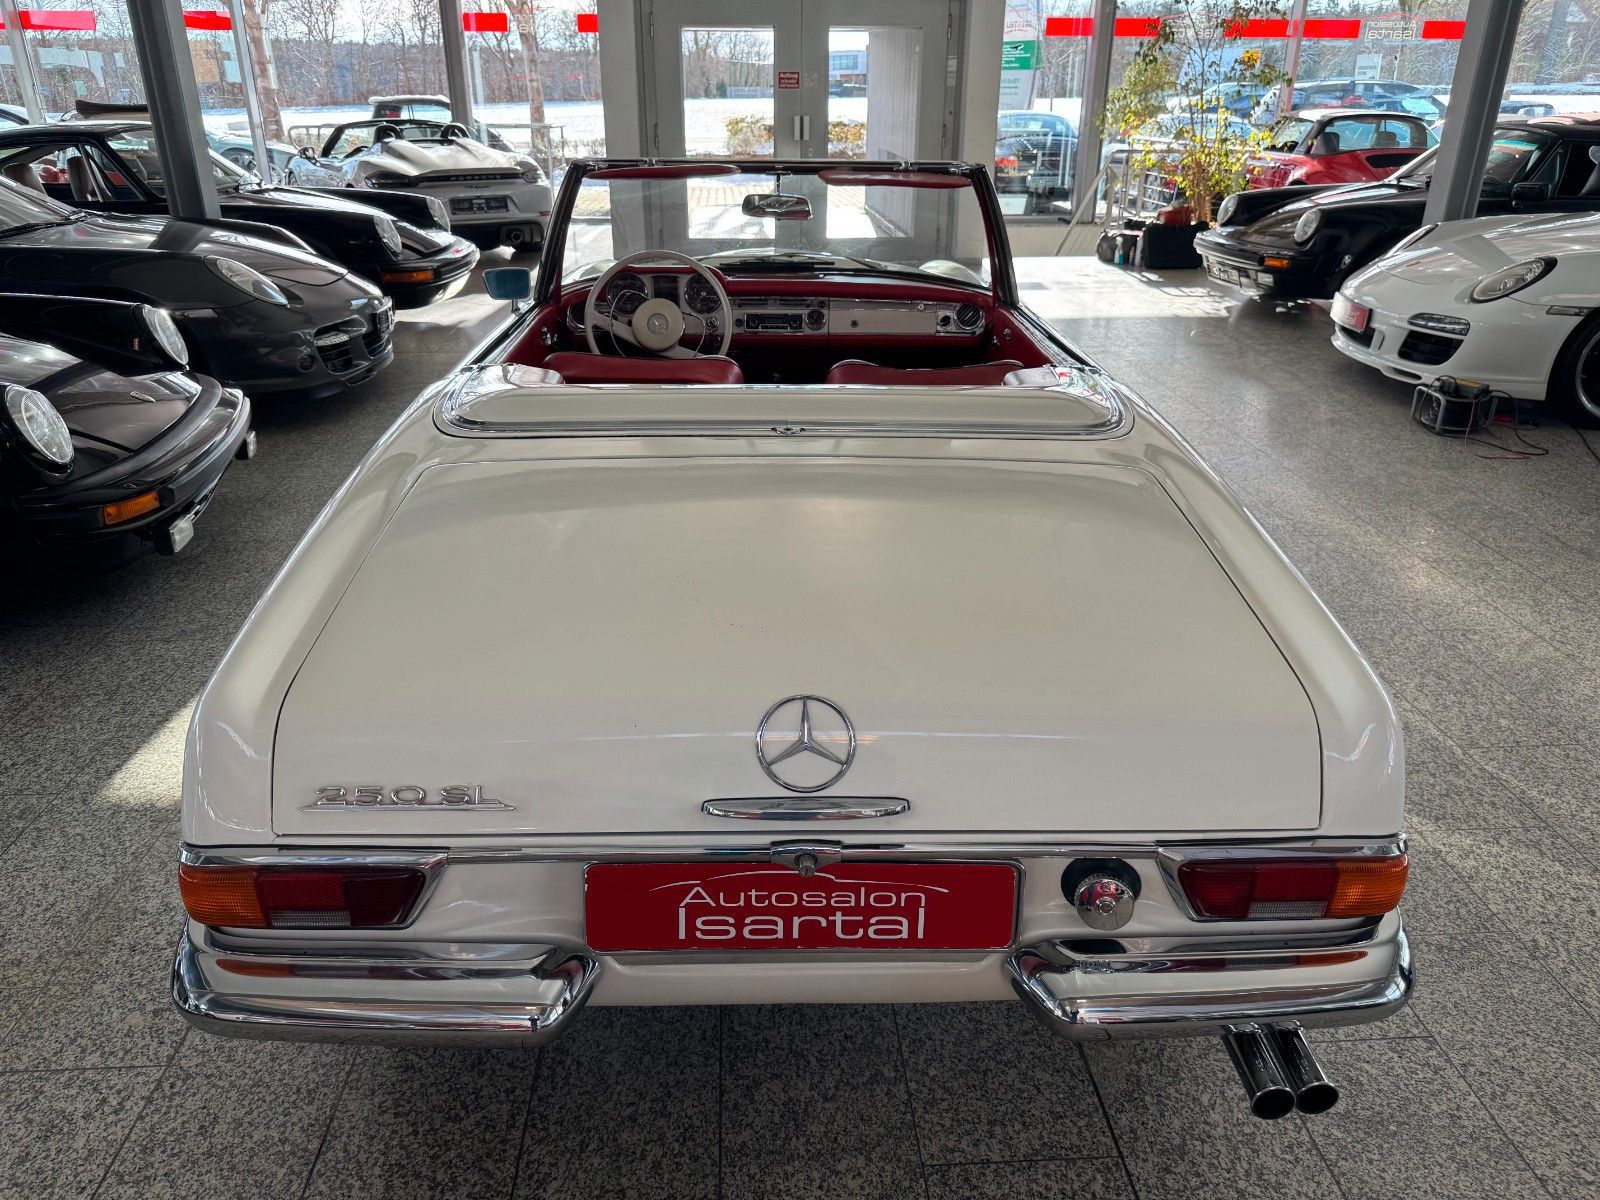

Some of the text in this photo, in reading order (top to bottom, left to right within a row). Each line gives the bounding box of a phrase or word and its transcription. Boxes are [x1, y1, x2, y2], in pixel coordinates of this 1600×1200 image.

[316, 785, 504, 806] 250 SL
[679, 886, 926, 907] Autosalon
[678, 907, 925, 940] Isartal
